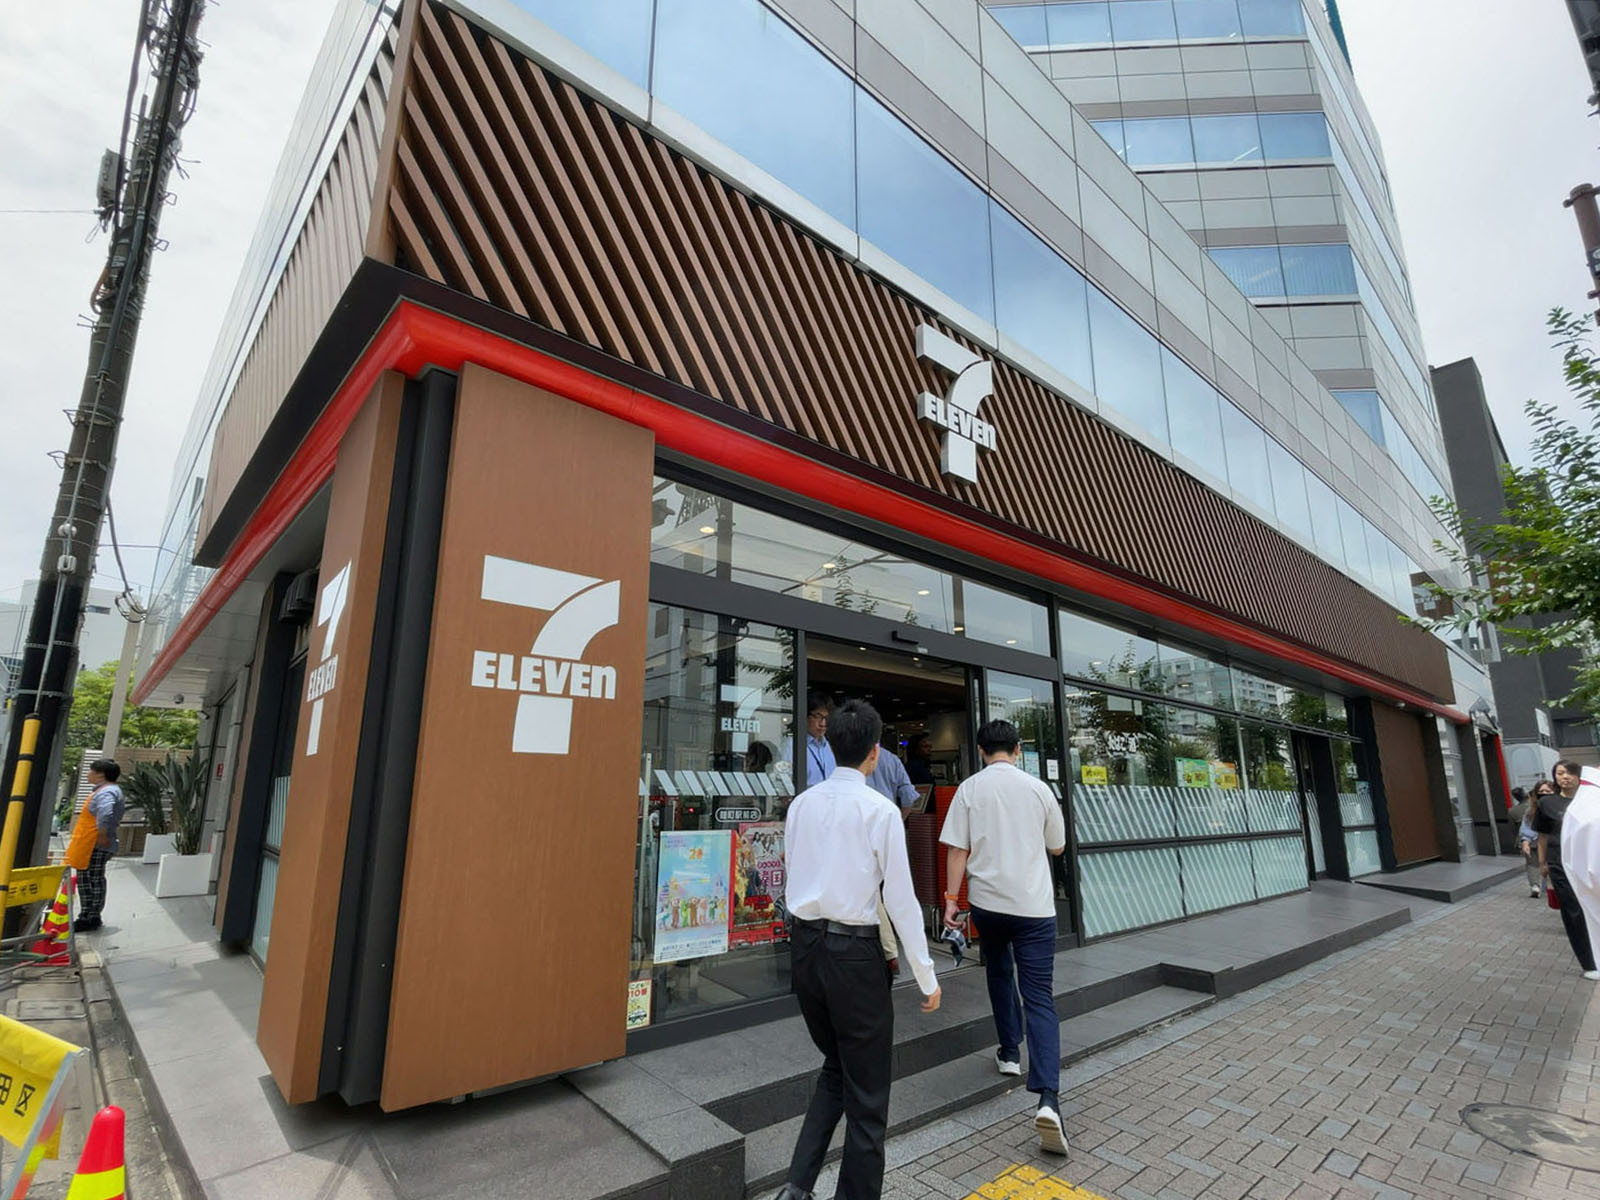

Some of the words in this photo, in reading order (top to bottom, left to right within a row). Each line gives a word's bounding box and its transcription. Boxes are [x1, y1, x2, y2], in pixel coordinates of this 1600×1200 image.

[916, 322, 993, 484] 7
[306, 559, 352, 756] 7
[481, 554, 621, 755] 7
[721, 684, 762, 752] 7
